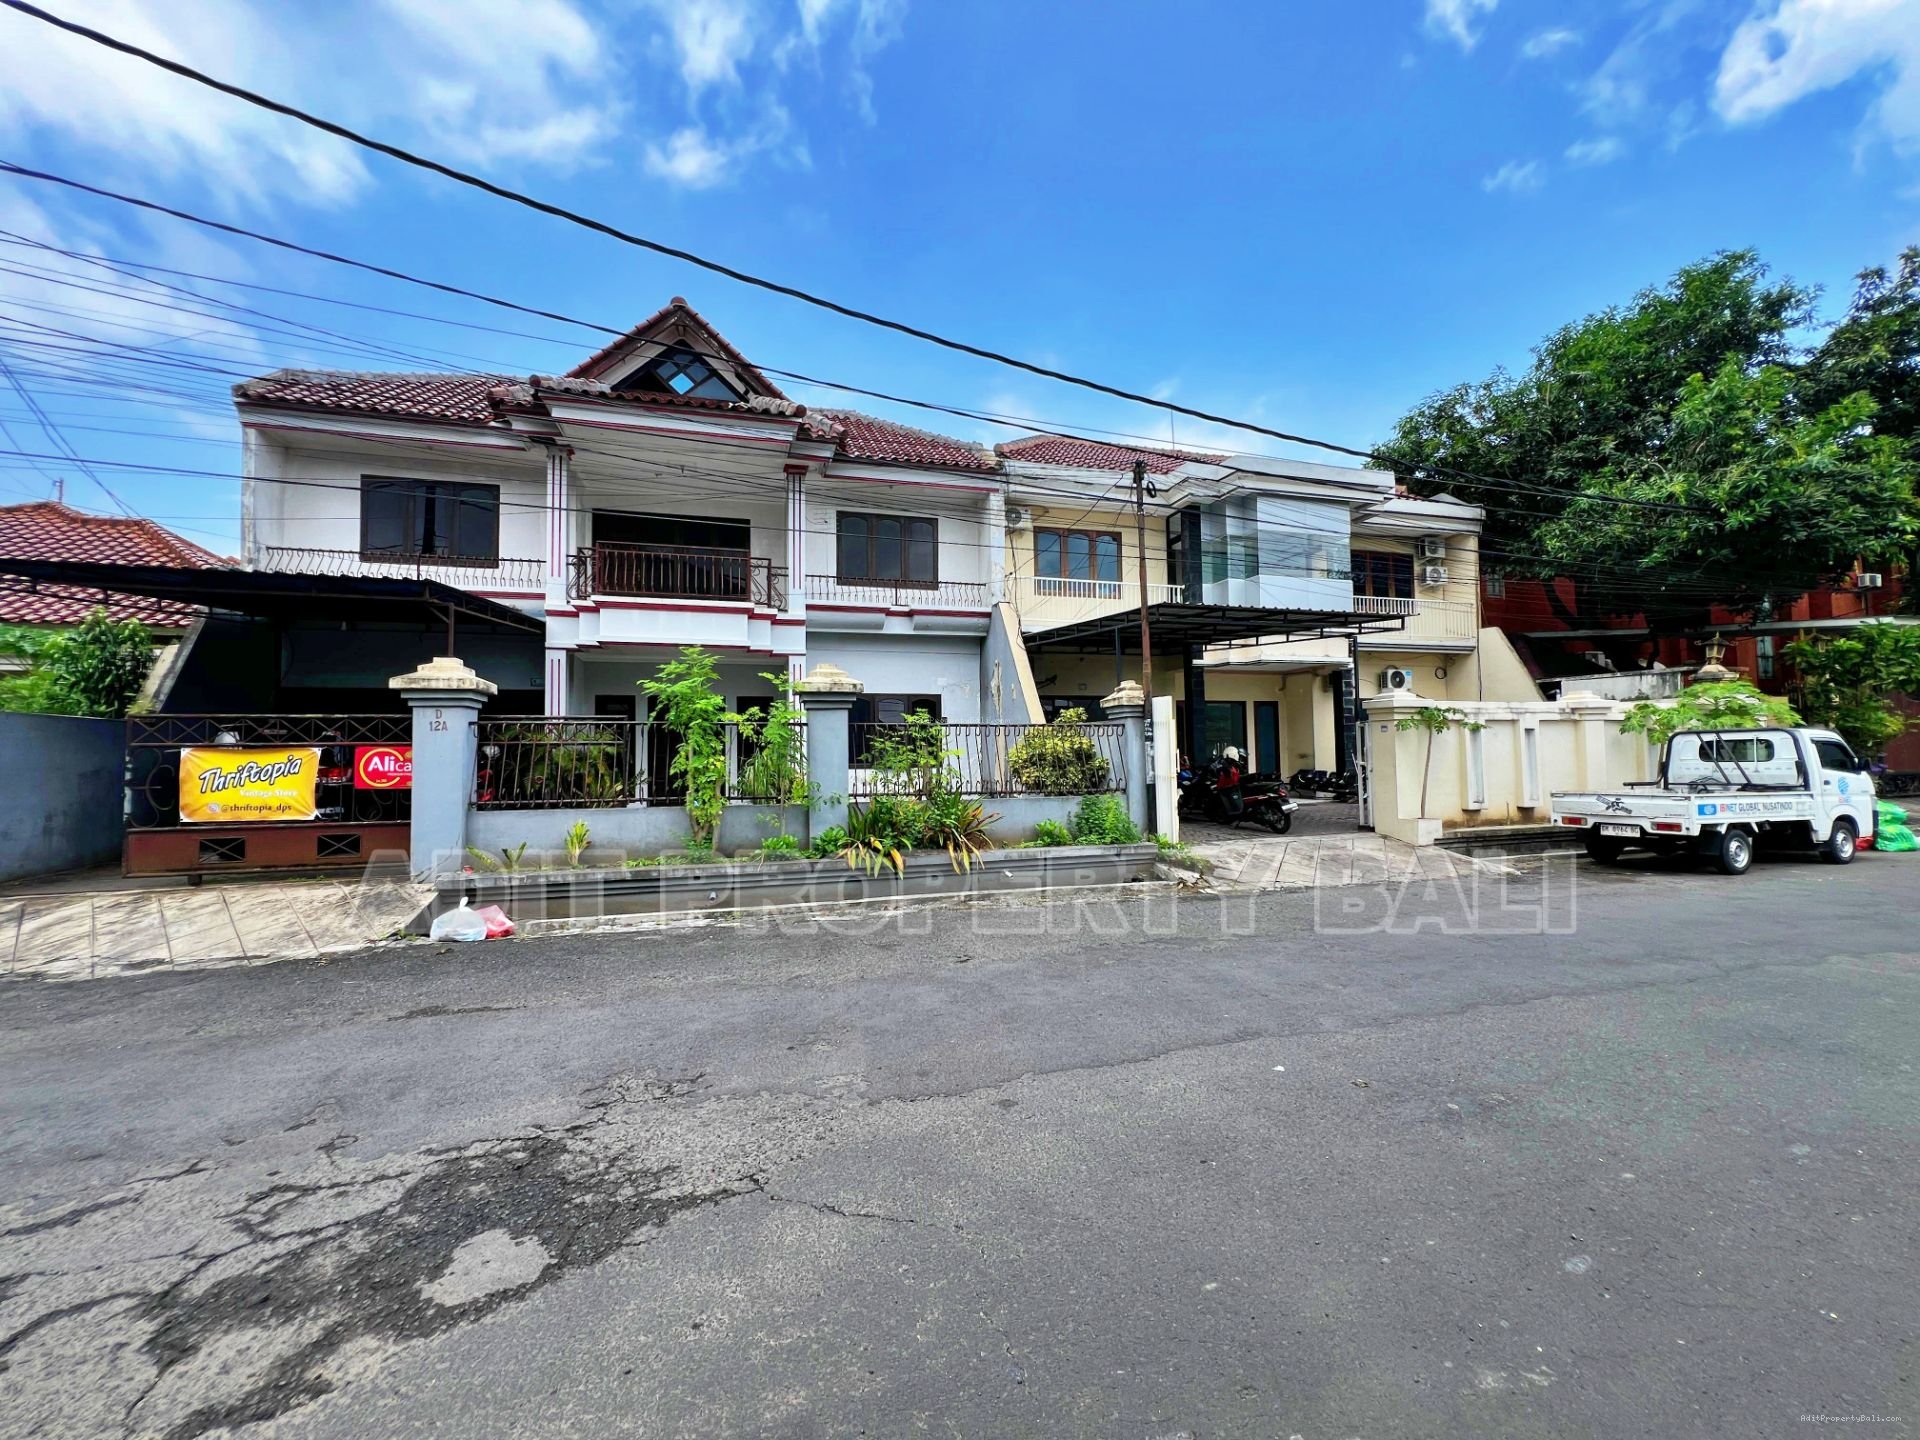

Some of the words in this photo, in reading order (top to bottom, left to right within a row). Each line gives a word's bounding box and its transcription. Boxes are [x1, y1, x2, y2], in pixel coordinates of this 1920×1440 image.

[435, 709, 443, 719] D
[429, 720, 448, 731] 12A
[199, 755, 302, 794] Thriftopia
[239, 789, 273, 799] Vintage
[274, 789, 299, 798] Store
[221, 803, 292, 813] @thriftopia_dps
[1738, 803, 1761, 812] GLOBAL
[1763, 801, 1793, 811] NUSATINDO
